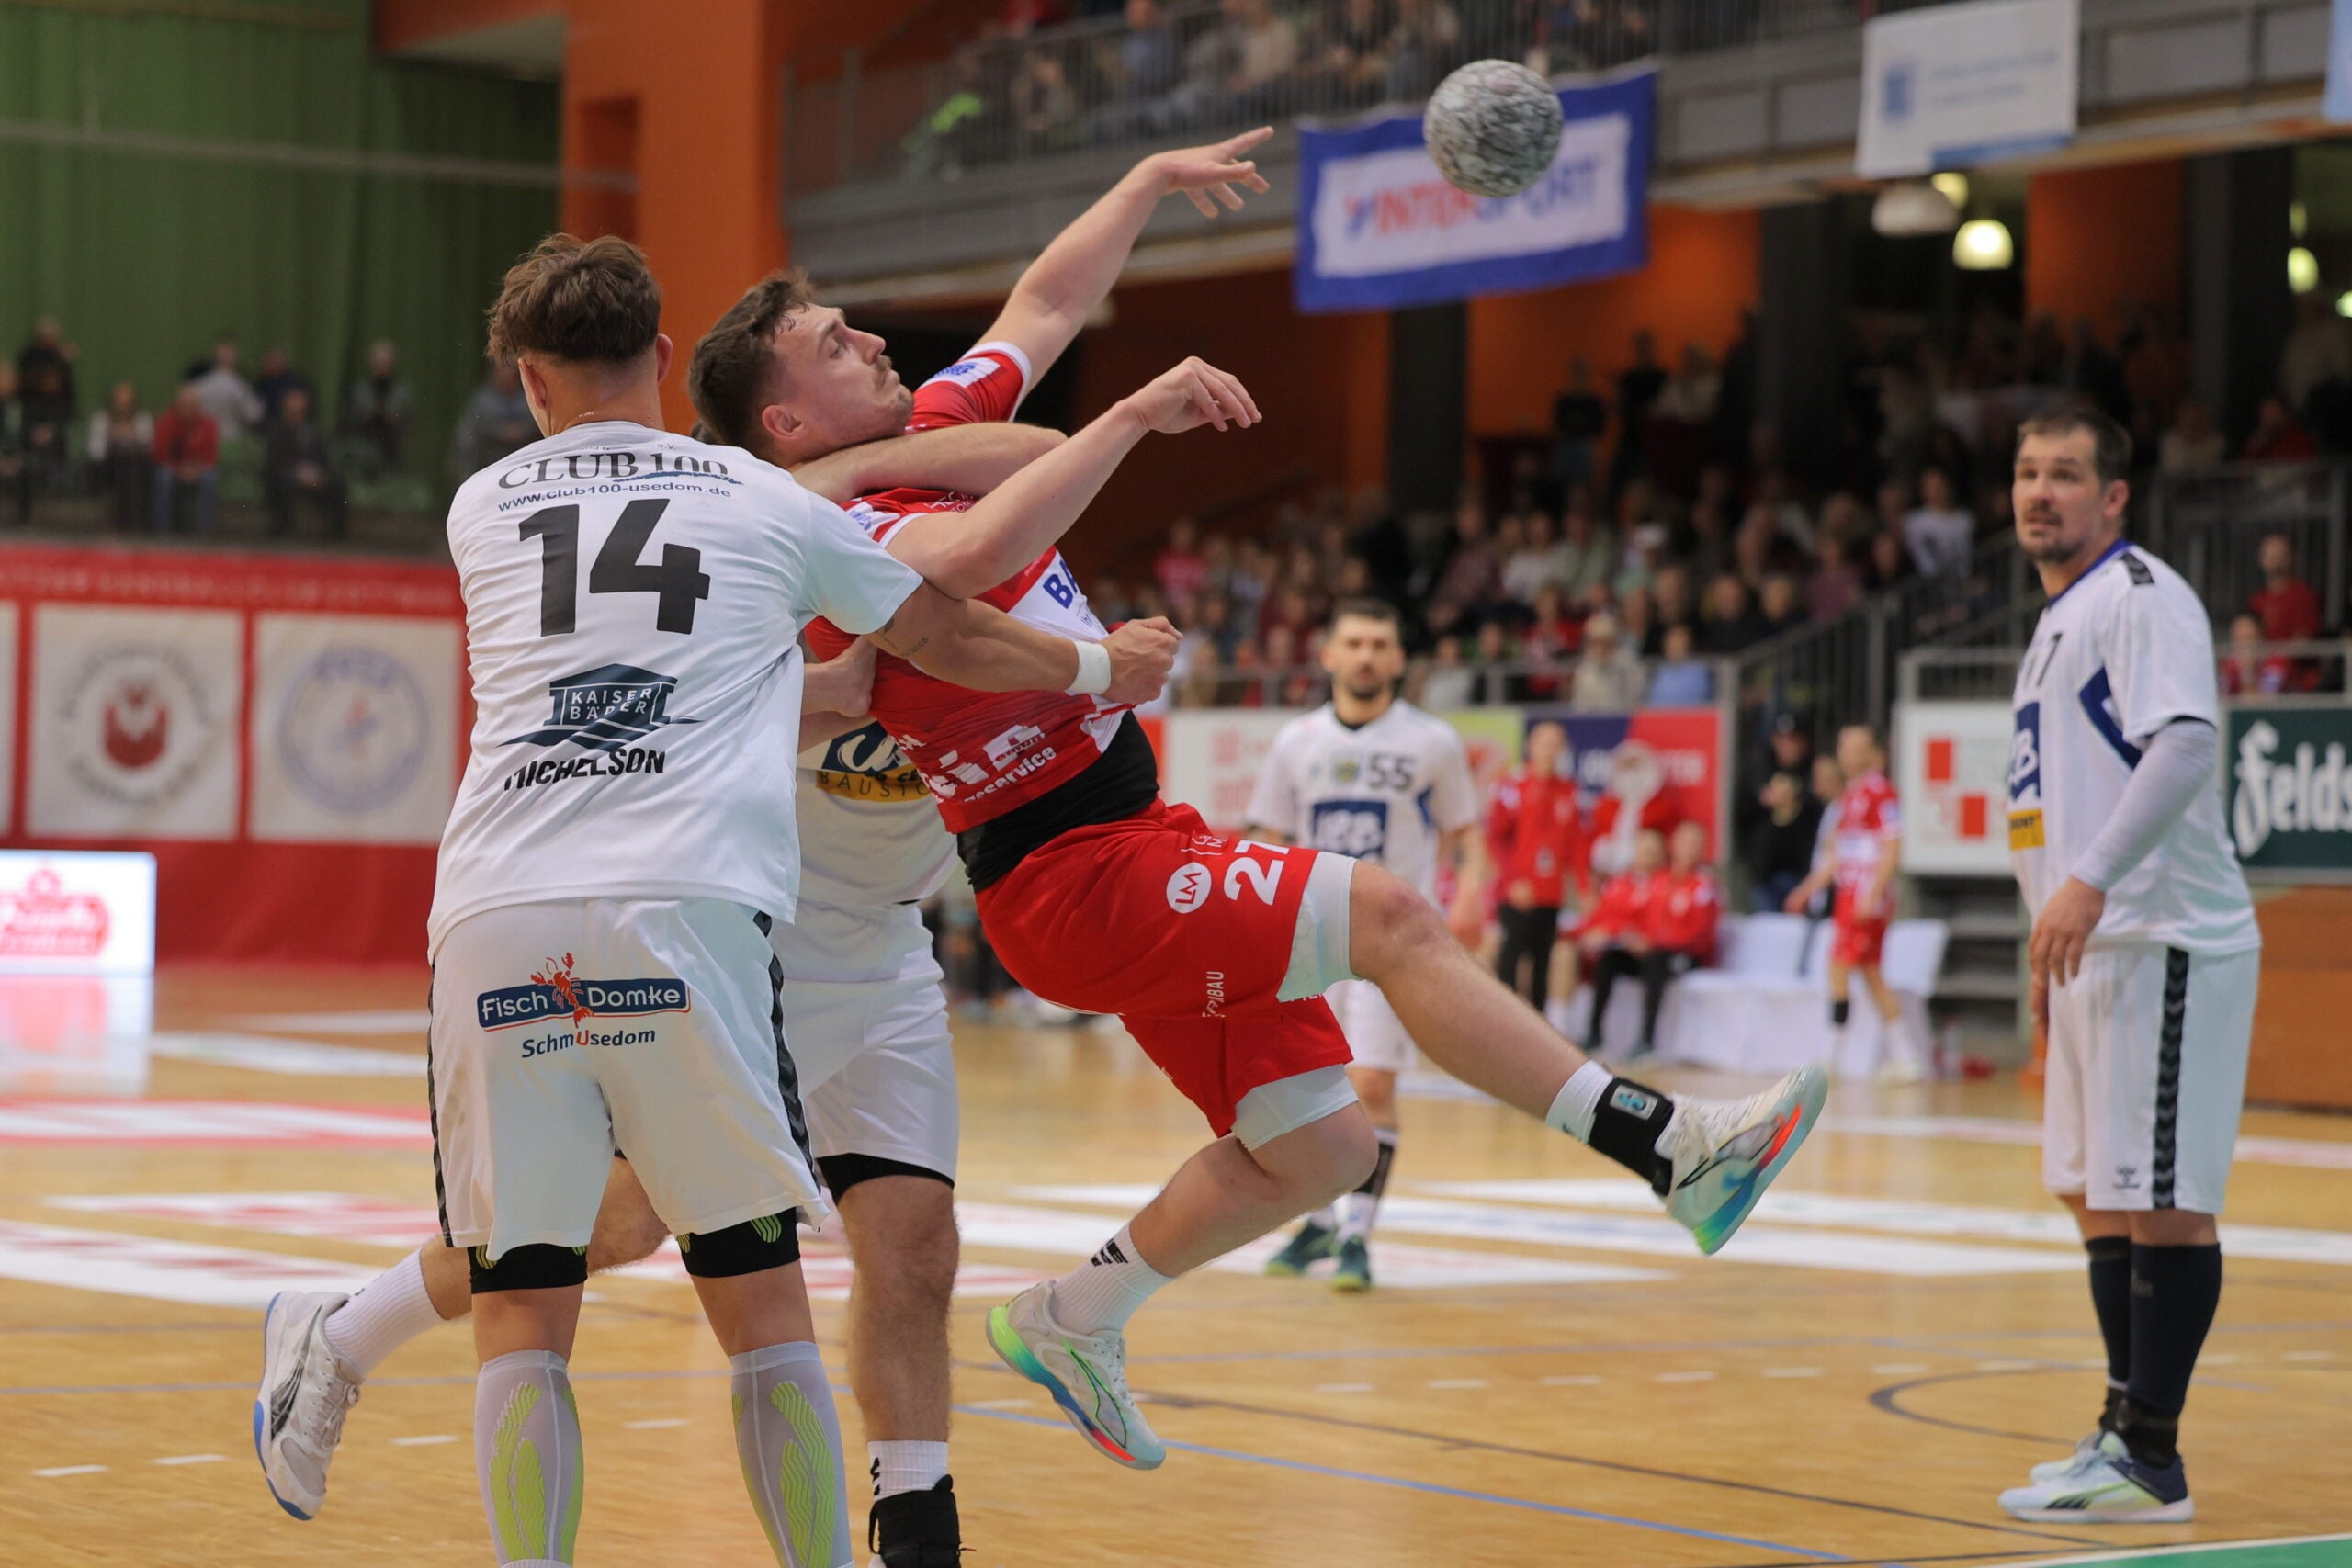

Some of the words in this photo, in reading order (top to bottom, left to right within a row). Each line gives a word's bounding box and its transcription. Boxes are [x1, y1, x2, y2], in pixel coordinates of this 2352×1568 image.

[497, 451, 639, 490] CLUB
[650, 451, 729, 476] 100
[497, 481, 732, 513] www.club100-usedom.de
[518, 498, 711, 637] 14
[571, 687, 653, 705] KAISER
[1367, 753, 1414, 791] 55
[481, 991, 548, 1021] Fisch
[586, 985, 682, 1008] Domke
[521, 1029, 656, 1058] SchmUsedom
